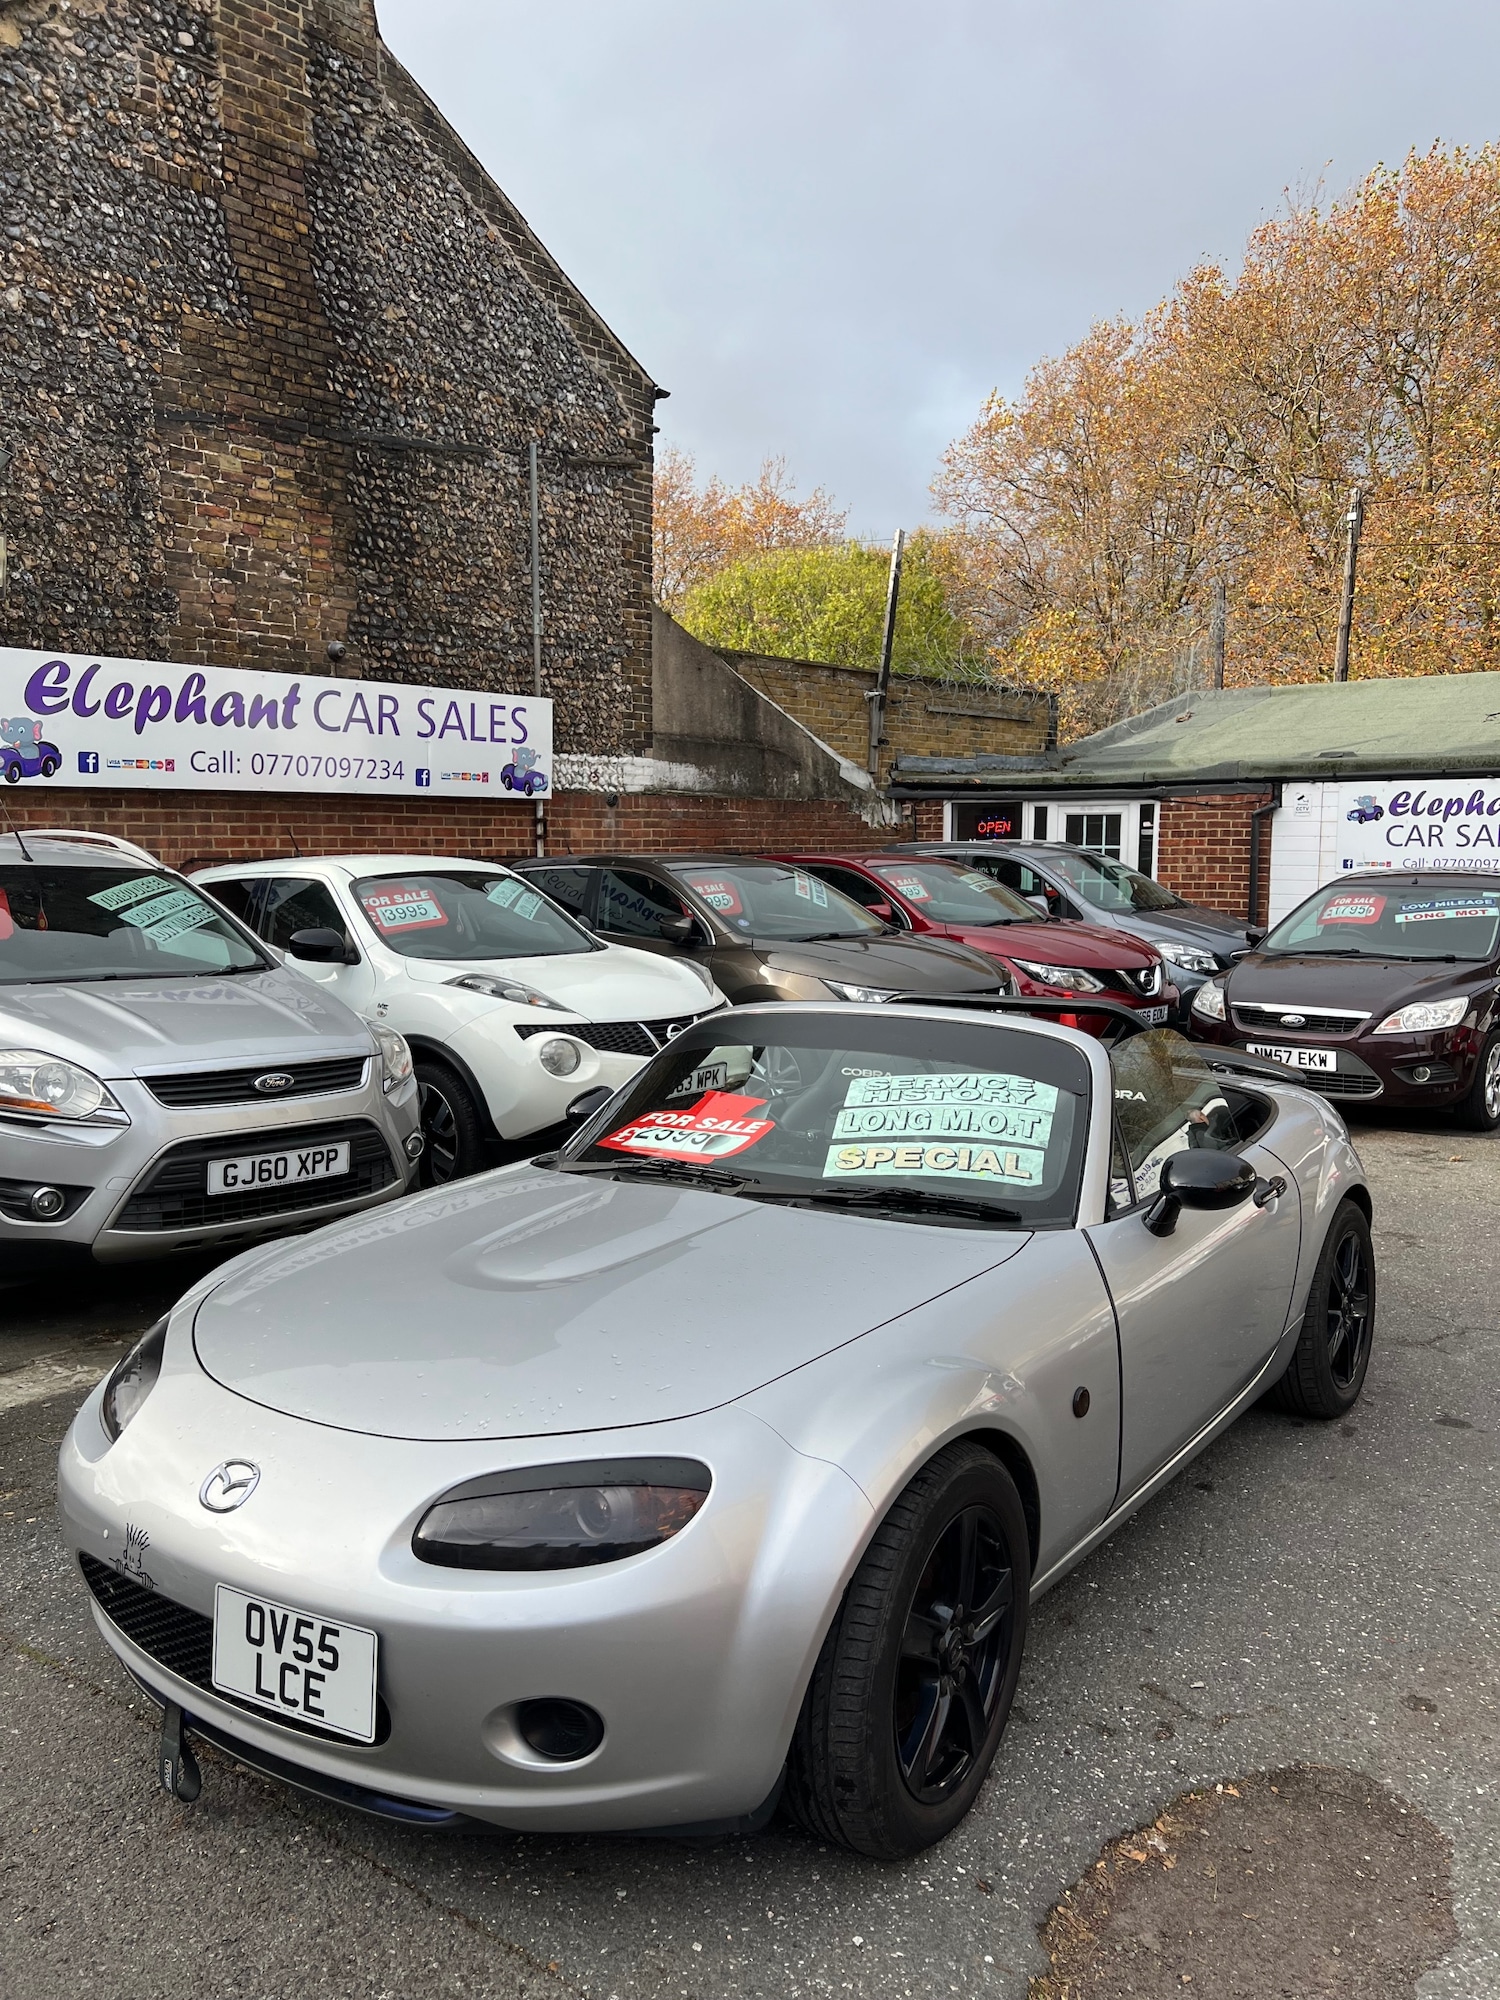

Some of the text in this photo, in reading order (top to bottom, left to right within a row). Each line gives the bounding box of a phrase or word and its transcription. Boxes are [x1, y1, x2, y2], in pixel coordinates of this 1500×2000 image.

[24, 660, 529, 745] Elephant CAR SALES
[190, 750, 405, 781] Call: 07707097234
[977, 821, 1011, 833] OPEN
[1386, 824, 1500, 847] CAR SA
[704, 883, 725, 892] SALE
[897, 877, 919, 885] SALE
[361, 890, 430, 907] FOR SALE
[1334, 897, 1351, 905] FOR
[1402, 899, 1493, 911] LOW MILEAGE
[1404, 912, 1446, 921] LONG
[1298, 1051, 1327, 1068] EKW
[697, 1068, 720, 1089] WPK
[841, 1066, 892, 1078] COBRA
[265, 1076, 286, 1088] Ford
[865, 1076, 1036, 1091] SERVICE
[863, 1088, 1037, 1104] HISTORY
[640, 1112, 768, 1134] FOR SALE
[841, 1109, 932, 1132] LONG
[224, 1149, 338, 1185] GJ60 XPP
[835, 1147, 1033, 1178] SPECIAL
[246, 1602, 340, 1672] OV55
[255, 1652, 326, 1718] LCE
